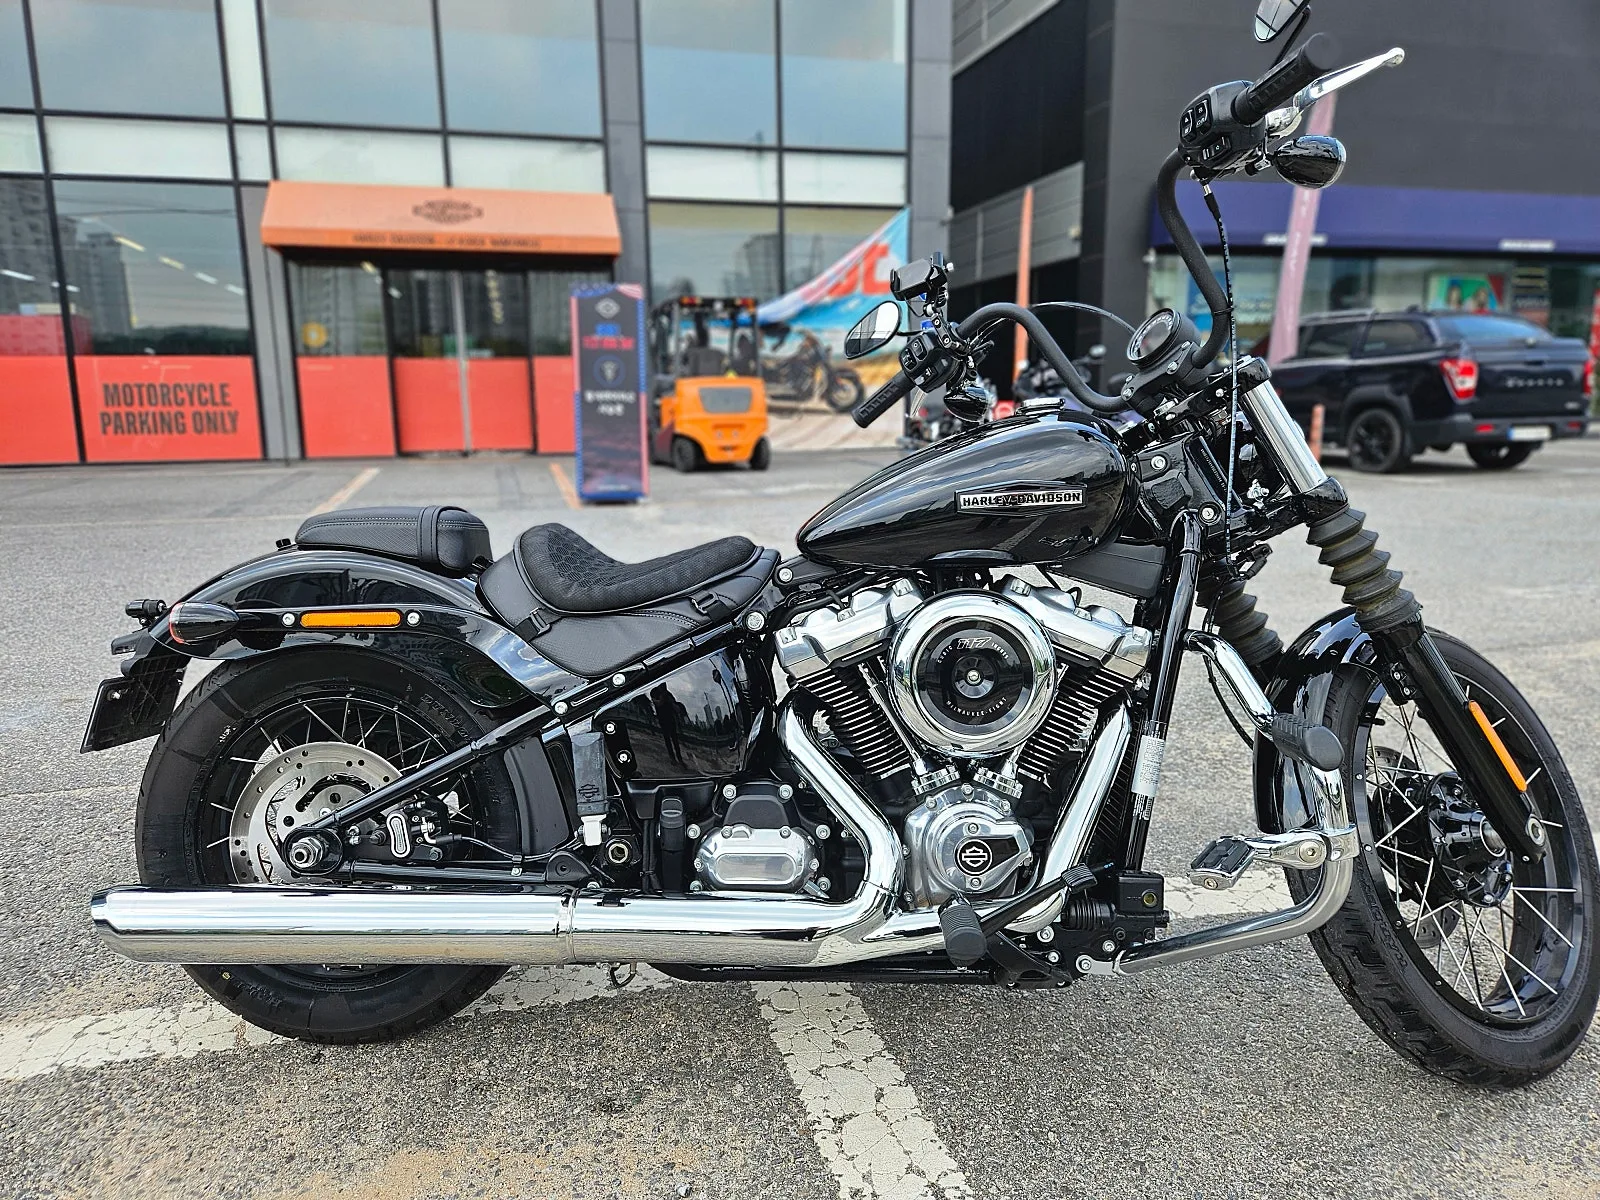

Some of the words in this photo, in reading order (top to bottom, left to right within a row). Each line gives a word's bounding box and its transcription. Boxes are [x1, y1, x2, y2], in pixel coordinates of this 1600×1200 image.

[102, 382, 231, 407] MOTORCYCLE
[99, 409, 187, 435] PARKING
[191, 409, 239, 434] ONLY
[420, 693, 470, 741] DUNLO
